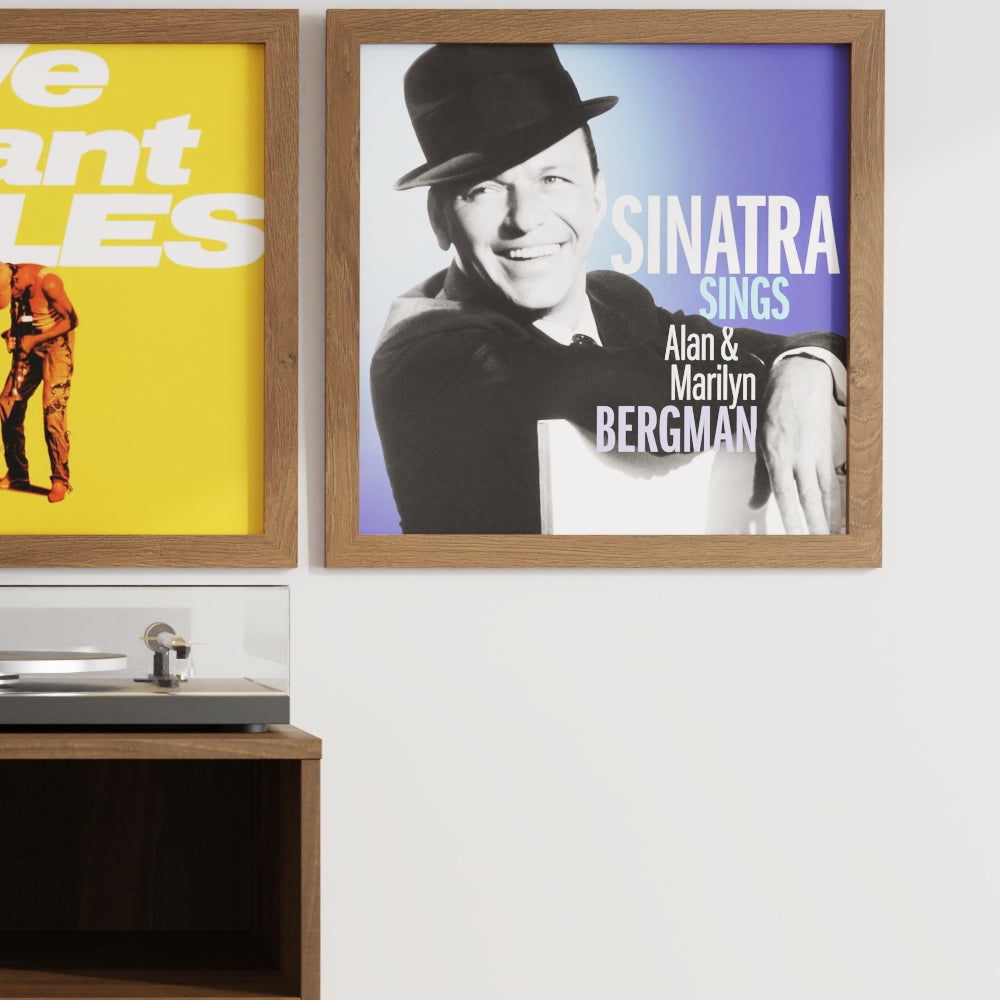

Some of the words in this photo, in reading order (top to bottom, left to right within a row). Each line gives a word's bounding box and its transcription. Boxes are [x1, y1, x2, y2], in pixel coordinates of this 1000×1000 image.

[610, 195, 840, 275] SINATRA
[699, 276, 790, 320] SINGS
[664, 324, 714, 361] Alan
[720, 326, 739, 361] &
[670, 363, 756, 410] Marilyn
[596, 405, 758, 453] BERGMAN
